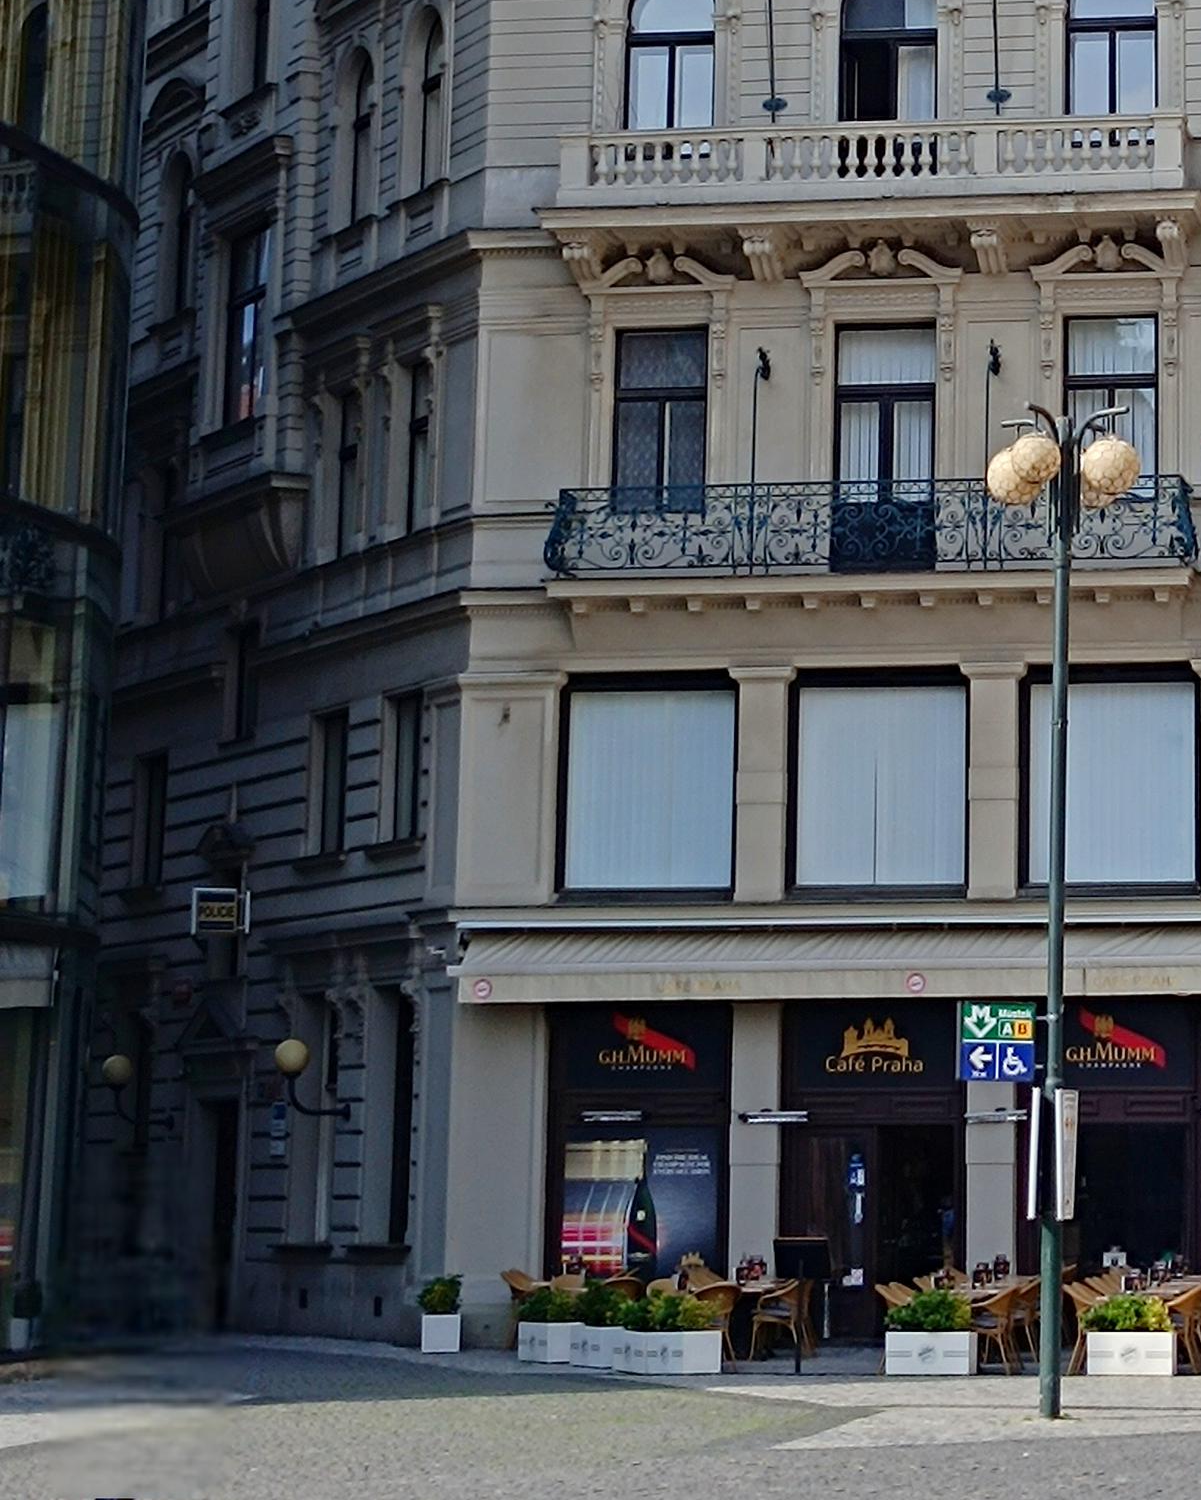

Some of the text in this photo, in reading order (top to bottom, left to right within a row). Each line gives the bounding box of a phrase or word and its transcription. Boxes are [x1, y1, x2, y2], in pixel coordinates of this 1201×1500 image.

[1002, 1022, 1028, 1036] A B
[825, 1055, 924, 1072] Café Praha
